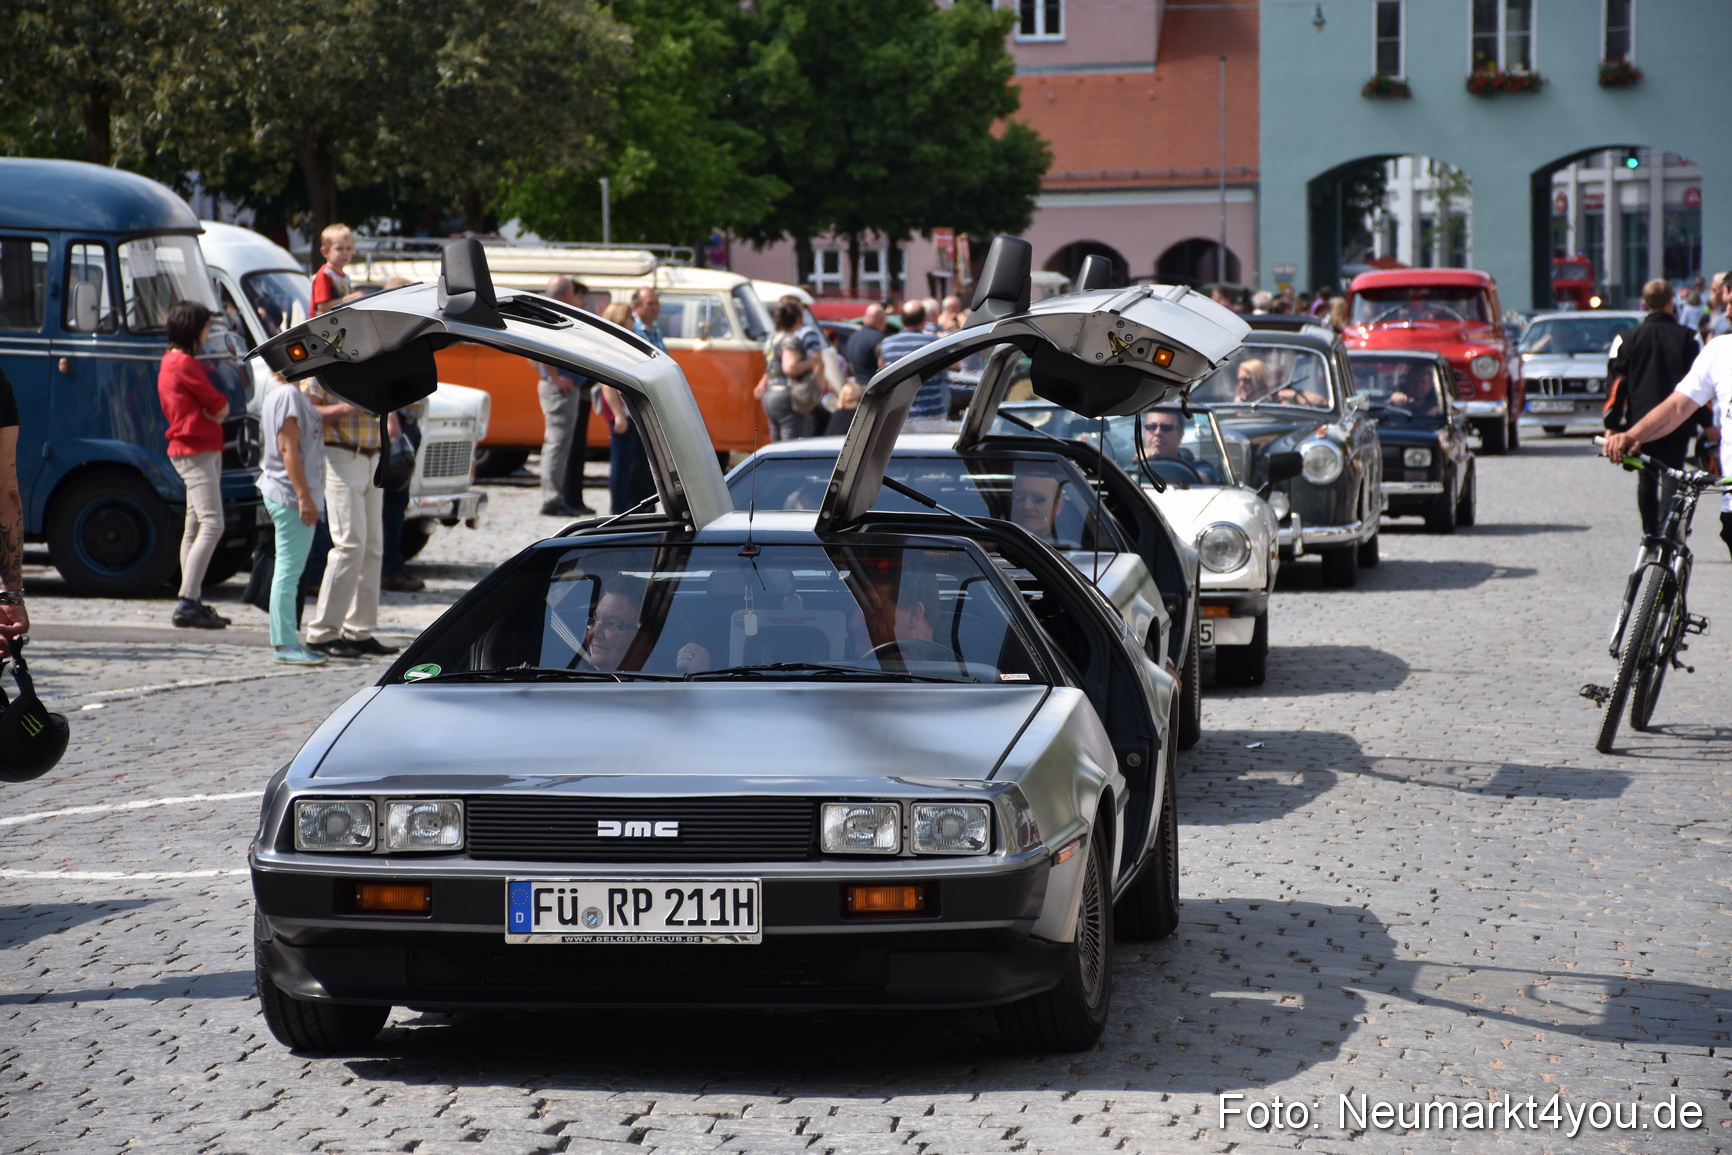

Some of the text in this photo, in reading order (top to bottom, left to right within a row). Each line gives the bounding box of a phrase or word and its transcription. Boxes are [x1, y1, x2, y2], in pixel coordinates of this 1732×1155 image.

[515, 912, 524, 923] D
[533, 887, 755, 927] FÜ RP 211H
